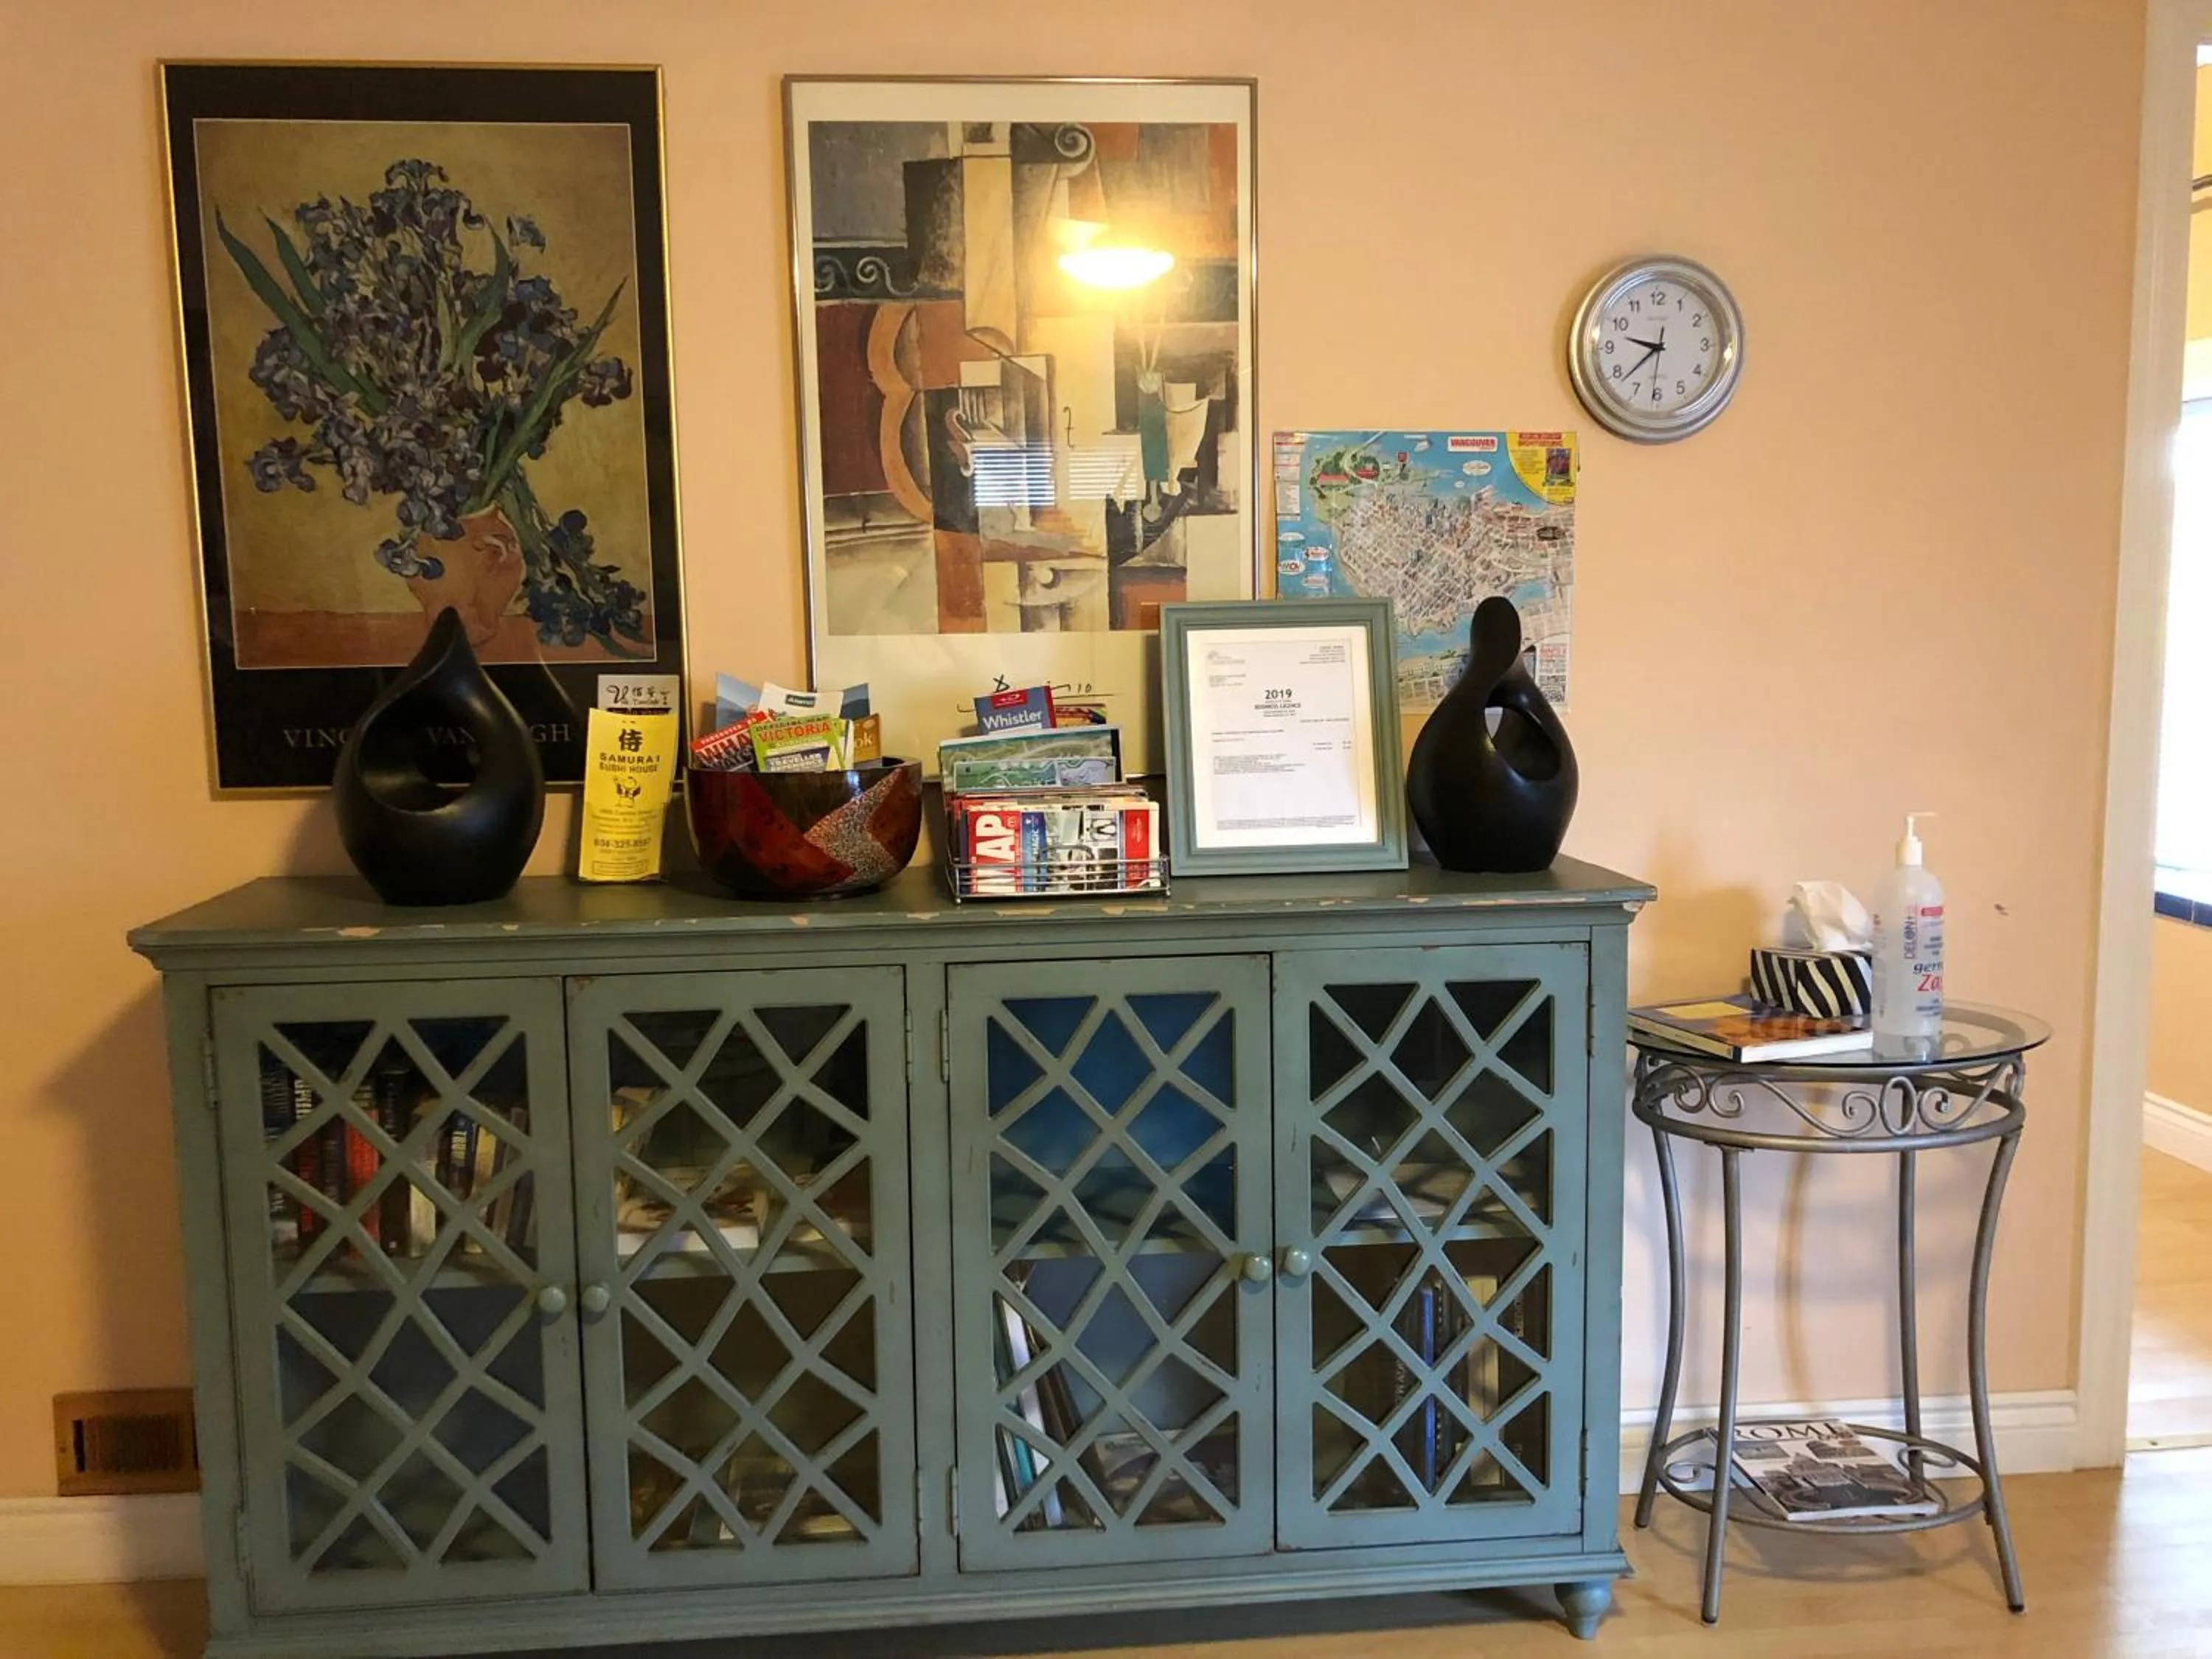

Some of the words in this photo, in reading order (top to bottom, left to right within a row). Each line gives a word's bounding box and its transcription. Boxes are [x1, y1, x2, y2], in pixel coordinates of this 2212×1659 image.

[1651, 291, 1666, 305] 12
[1628, 300, 1641, 313] 11
[1677, 299, 1683, 311] 1
[1613, 318, 1629, 331] 10
[1692, 314, 1702, 327] 2
[1604, 341, 1614, 354] 9
[1700, 338, 1709, 352] 3
[1613, 365, 1622, 378] 8
[1692, 364, 1702, 377] 4
[1632, 383, 1641, 395] 7
[1676, 380, 1685, 394] 5
[1653, 388, 1662, 401] 6
[1265, 689, 1293, 699] 2019
[983, 711, 1043, 730] Whistler
[283, 728, 348, 748] VINC
[529, 723, 571, 742] GH
[759, 722, 831, 742] VICTORIA
[599, 752, 661, 765] SAMURAI
[975, 814, 1016, 893] MAP
[1917, 973, 1942, 992] Za
